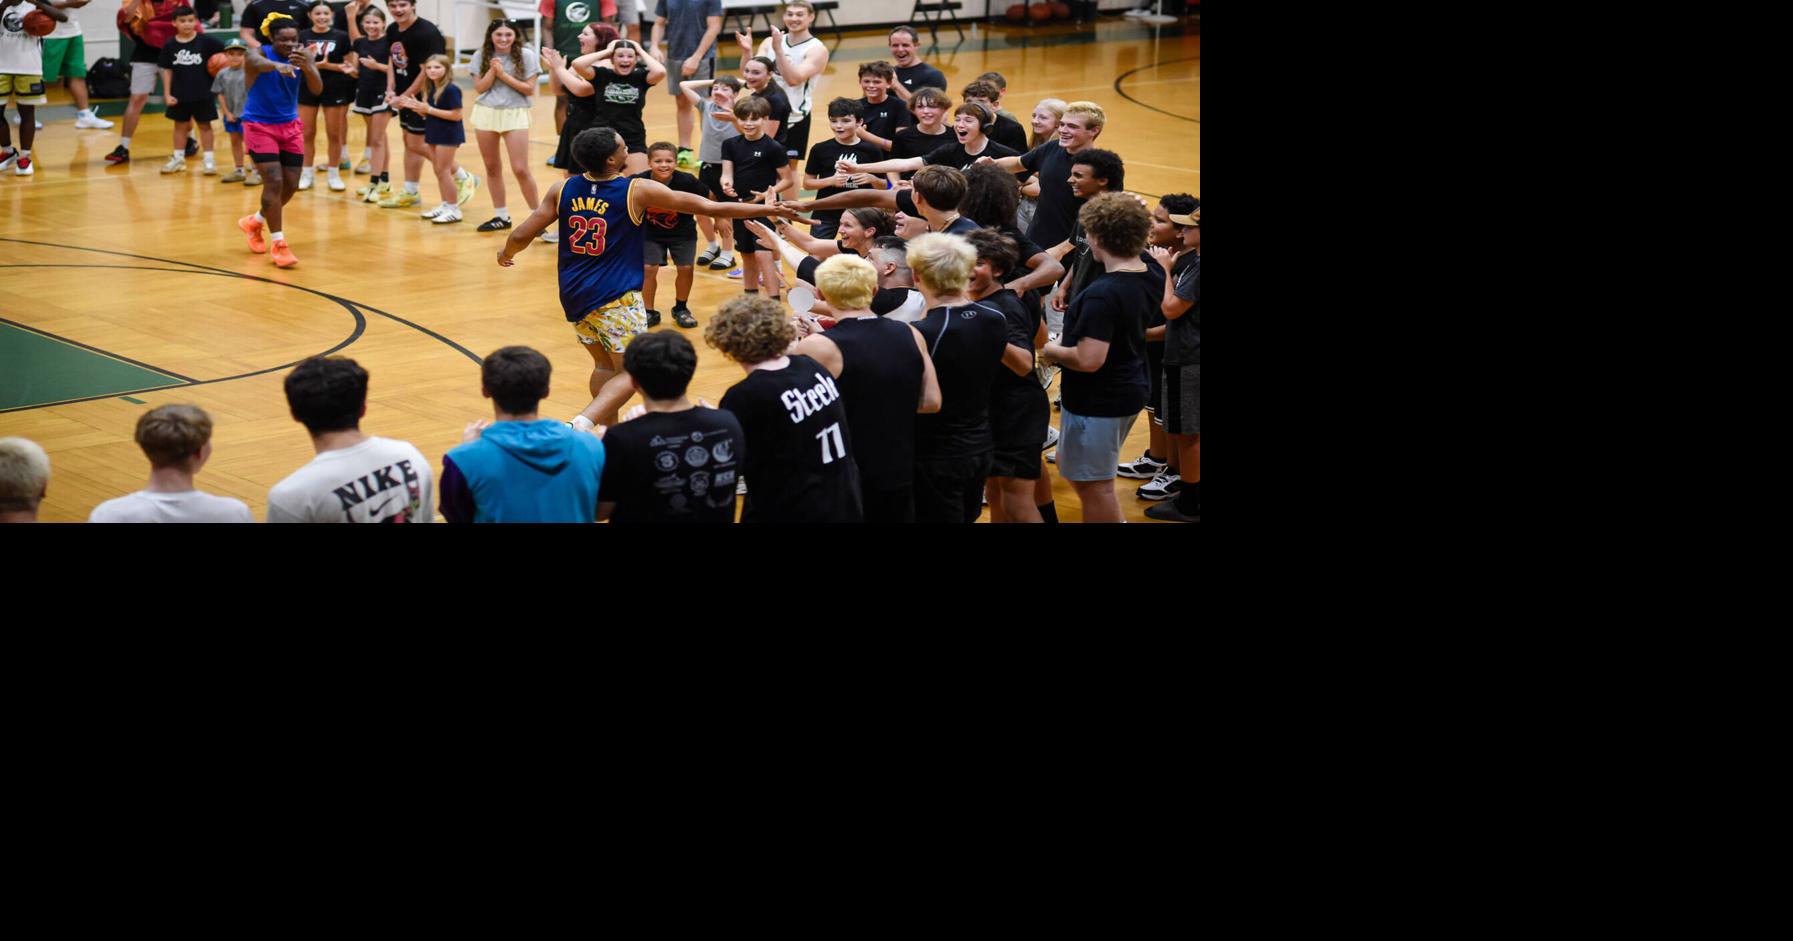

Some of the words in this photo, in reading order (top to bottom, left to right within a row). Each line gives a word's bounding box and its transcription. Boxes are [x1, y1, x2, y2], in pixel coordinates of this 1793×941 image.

[571, 196, 609, 215] JAMES
[568, 215, 607, 256] 23
[332, 459, 418, 511] NIKE
